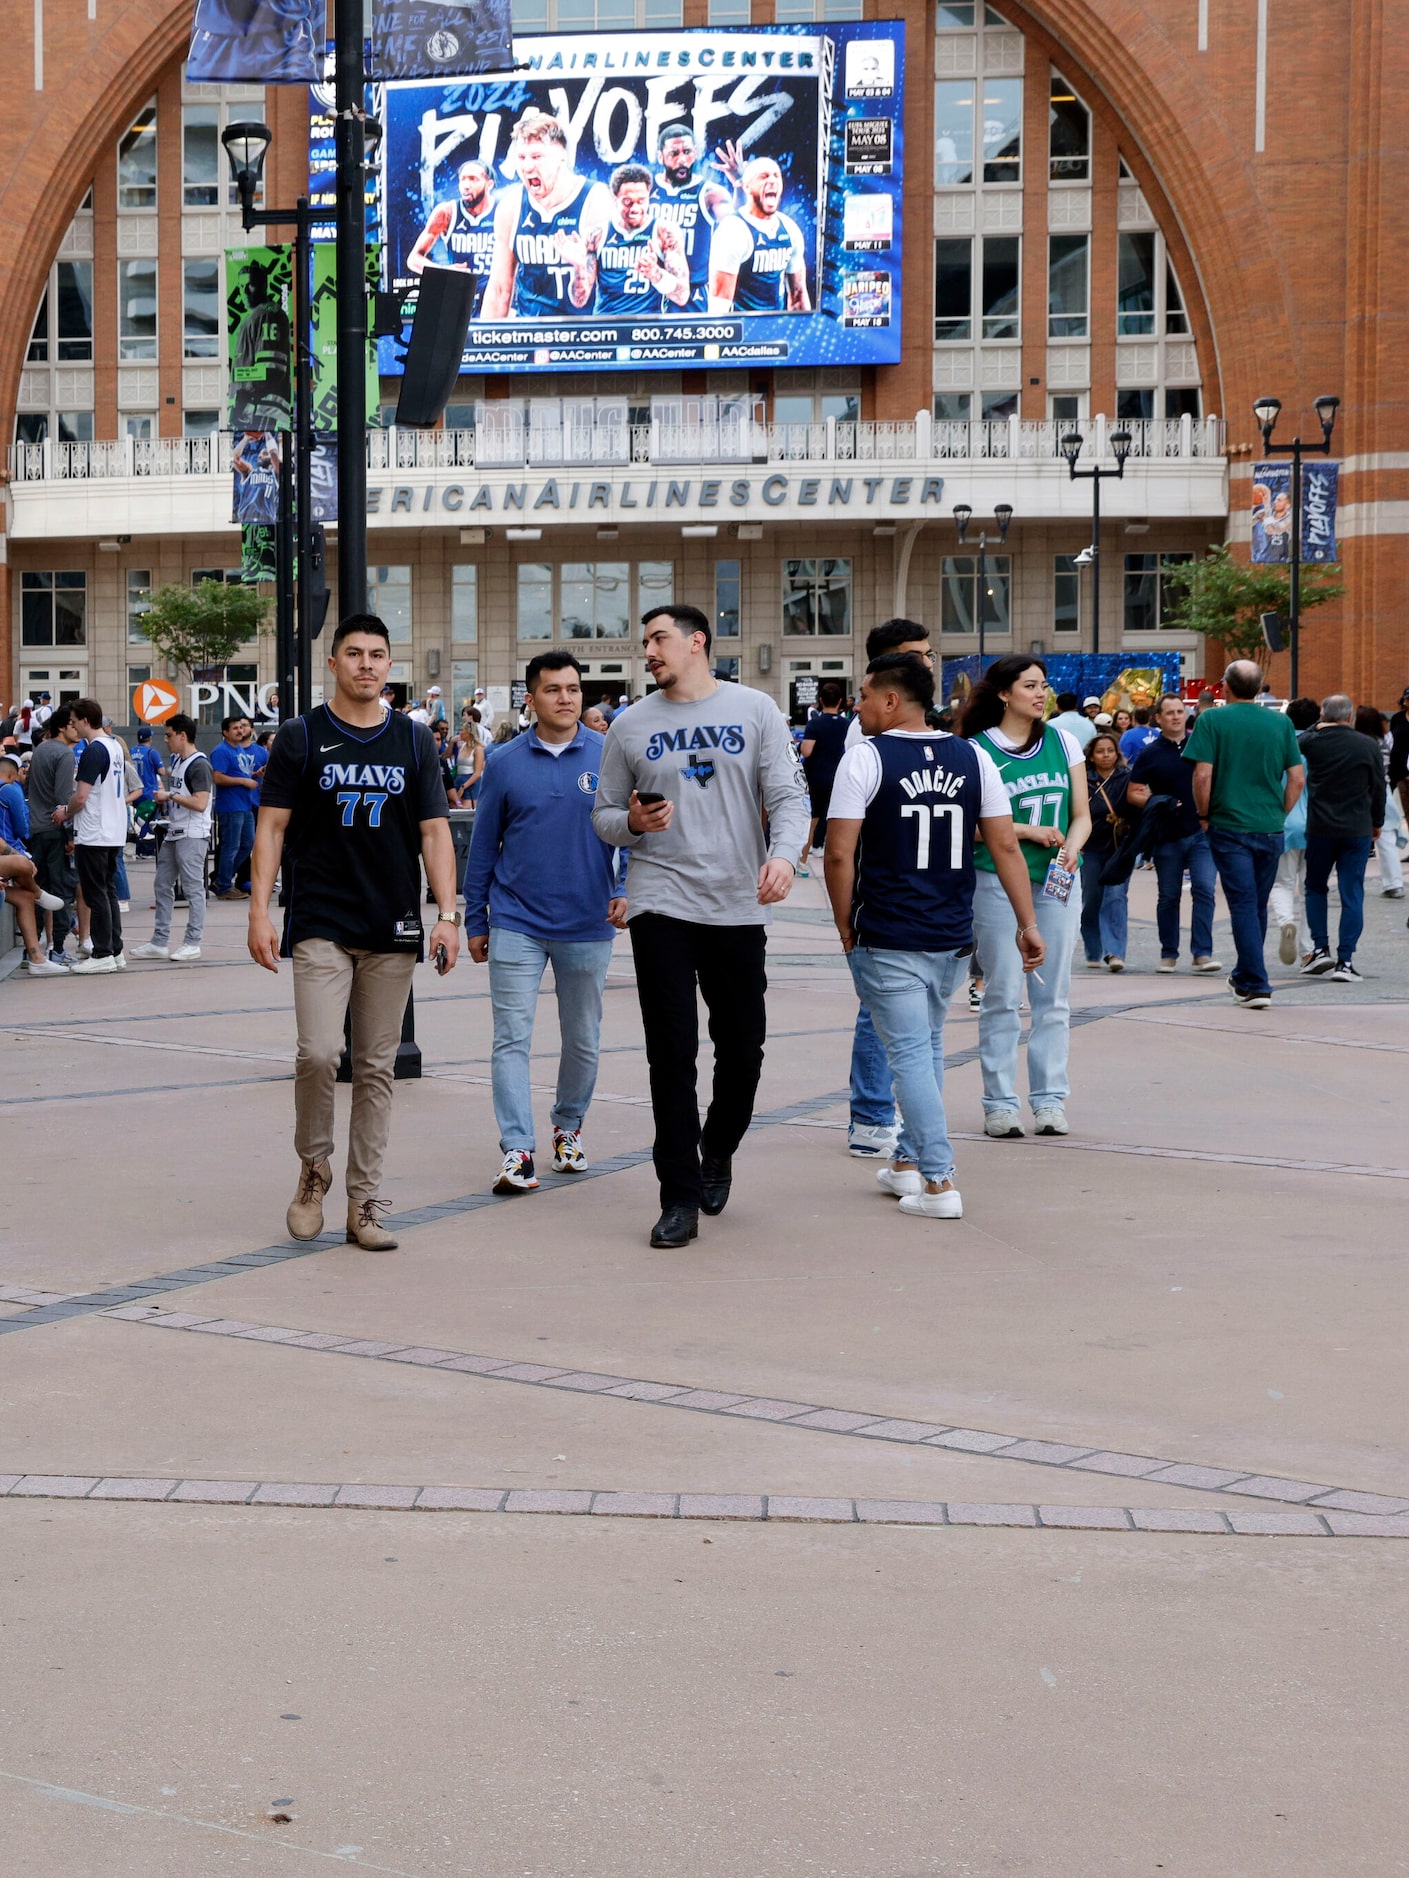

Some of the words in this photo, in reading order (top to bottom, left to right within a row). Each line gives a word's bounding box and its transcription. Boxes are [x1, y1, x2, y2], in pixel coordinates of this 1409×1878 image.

[440, 81, 533, 113] 2024
[849, 88, 865, 98] MAY
[851, 135, 874, 146] MAY
[854, 165, 872, 174] MAY
[853, 241, 872, 250] MAY
[623, 269, 650, 295] 25
[852, 319, 872, 327] MAY
[472, 328, 618, 345] ticketmaster.com
[631, 326, 735, 342] 800.745.3000
[549, 349, 613, 361] @AACenter
[631, 348, 697, 359] @AACenter
[721, 346, 780, 358] AACdallas
[1304, 471, 1331, 546] PLAYOFFS
[589, 645, 639, 653] ENTRANCE
[645, 724, 746, 761] MAVS
[319, 763, 405, 795] MAVS
[899, 765, 967, 800] DONČIĆ
[336, 792, 389, 827] 77
[1018, 792, 1064, 829] 77
[900, 803, 964, 870] 77
